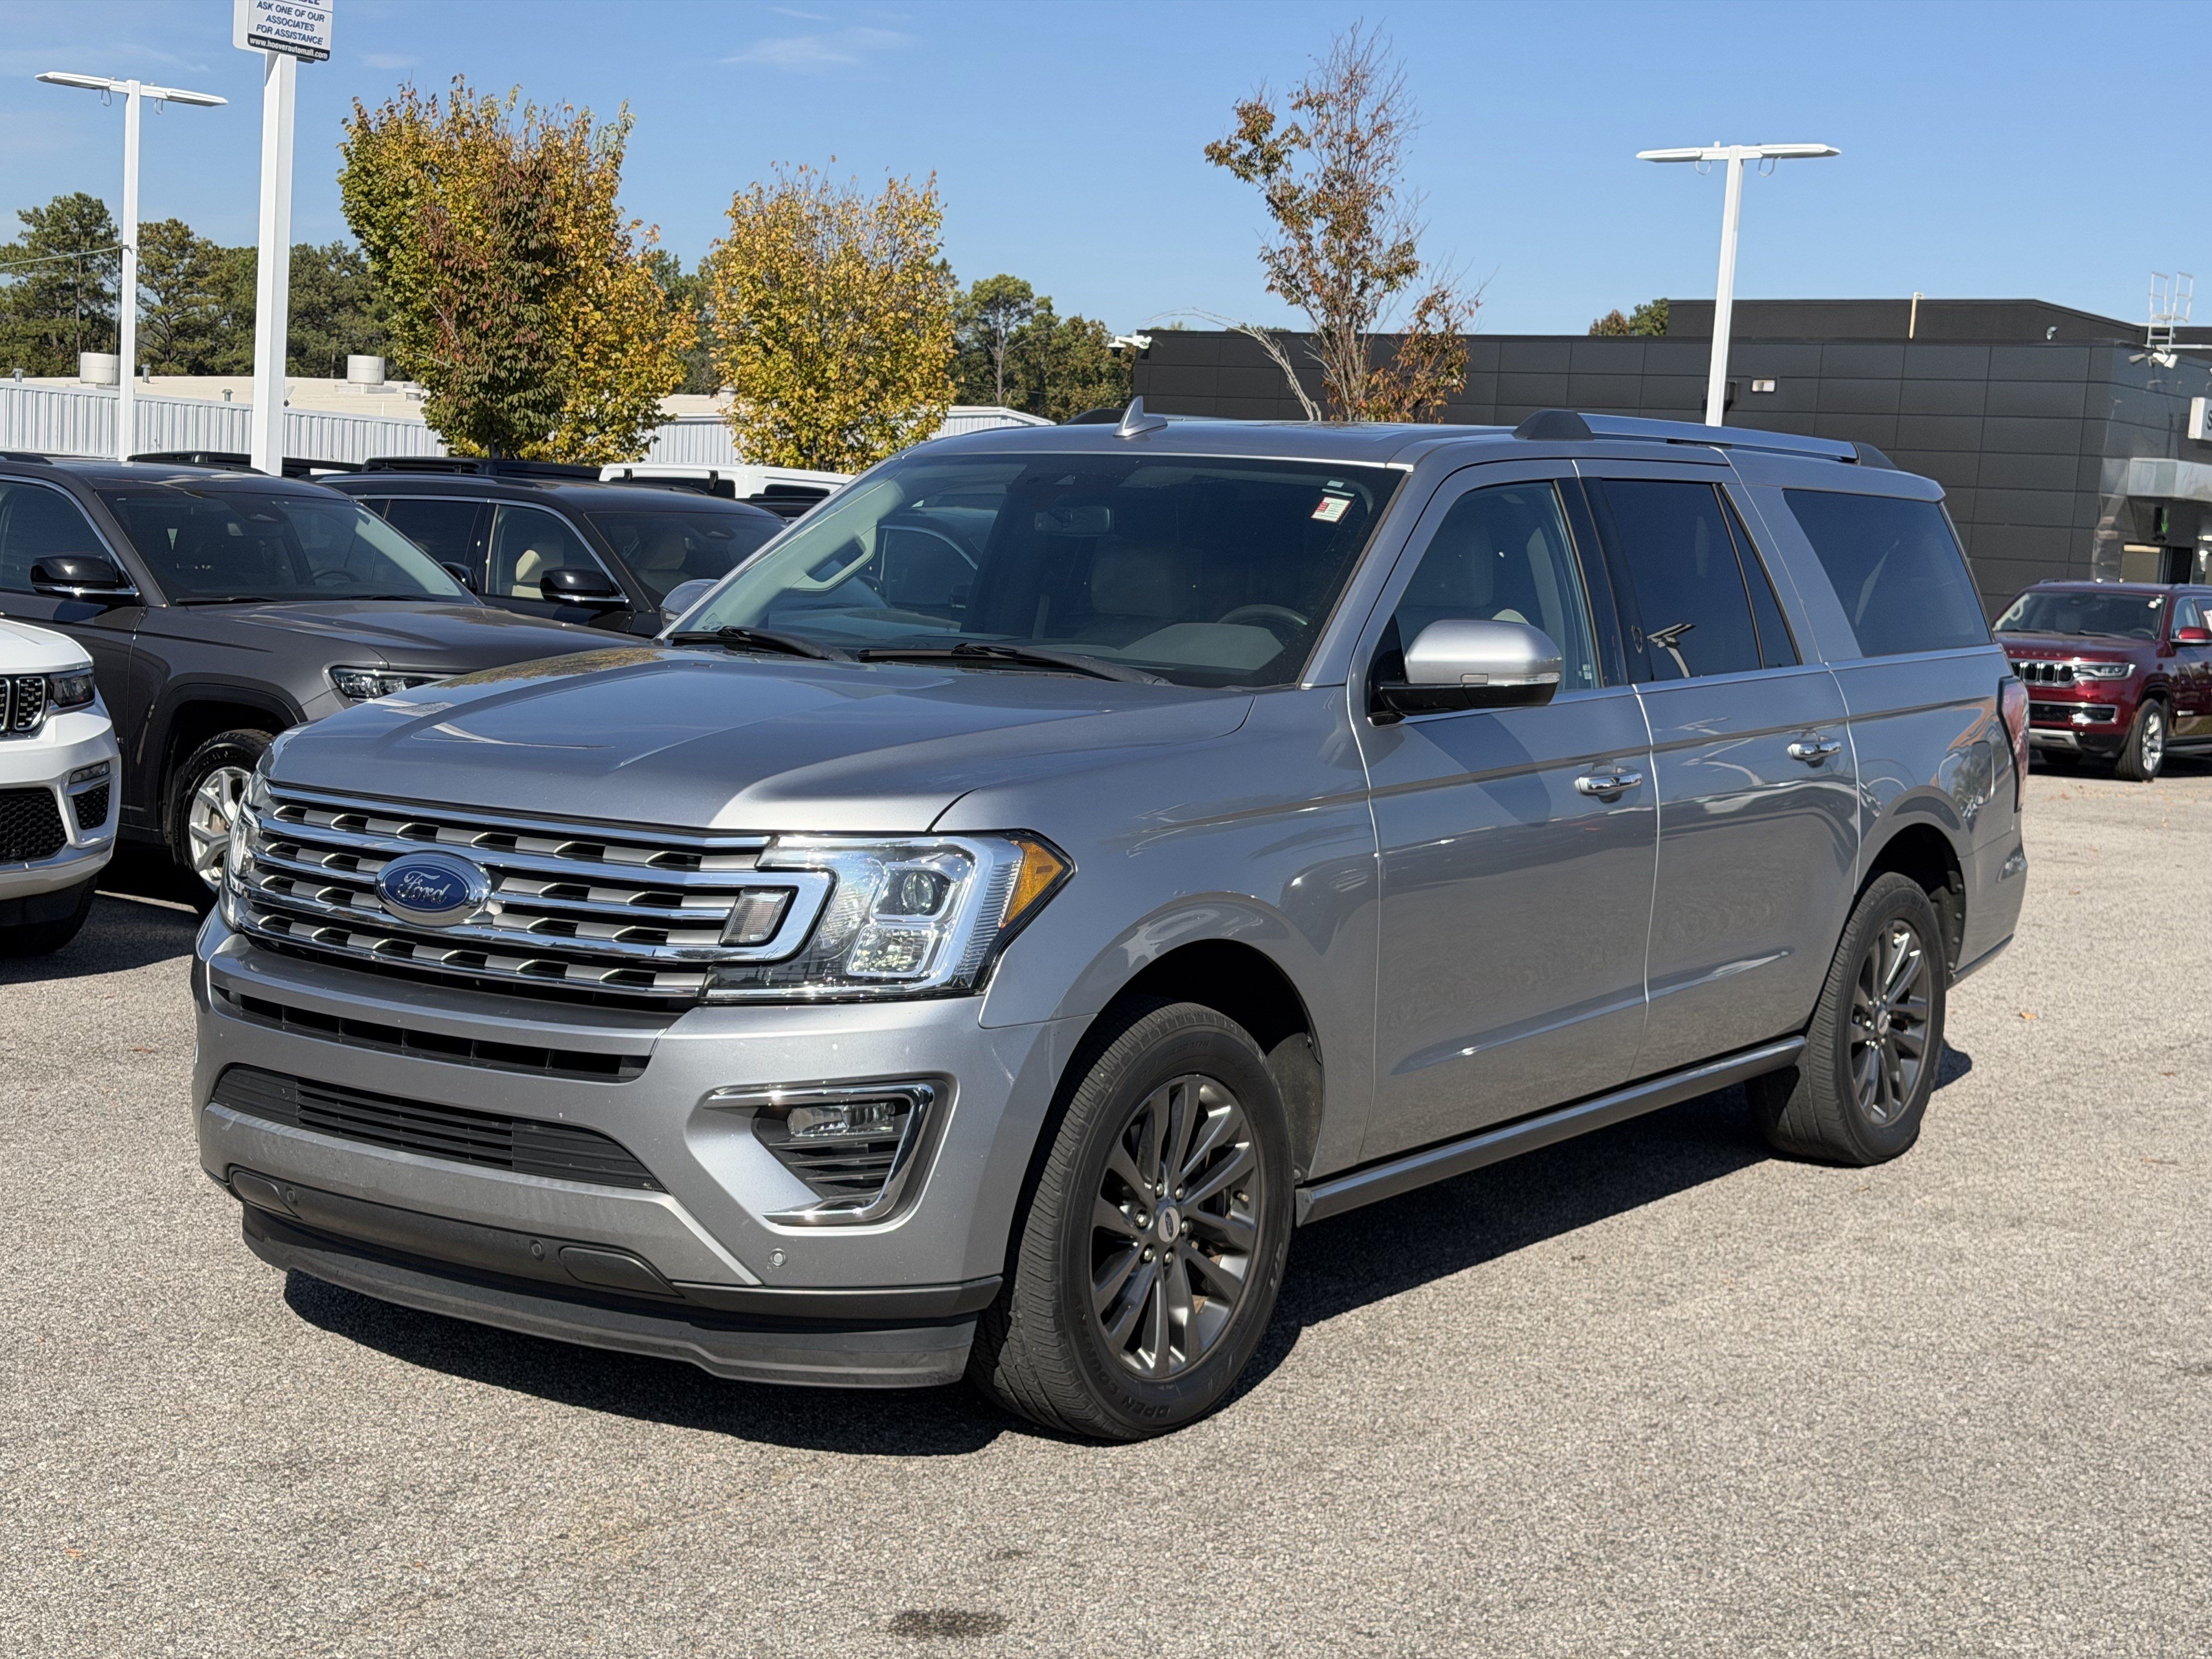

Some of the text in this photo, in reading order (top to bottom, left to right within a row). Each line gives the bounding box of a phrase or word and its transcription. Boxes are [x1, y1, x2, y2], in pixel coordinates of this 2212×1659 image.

[256, 2, 325, 22] ASK ONE OF OUR
[266, 14, 315, 32] ASSOCIATES
[256, 24, 323, 46] FOR ASSISTANCE
[250, 37, 328, 59] www.hooverautomall.com
[396, 871, 452, 904] Ford
